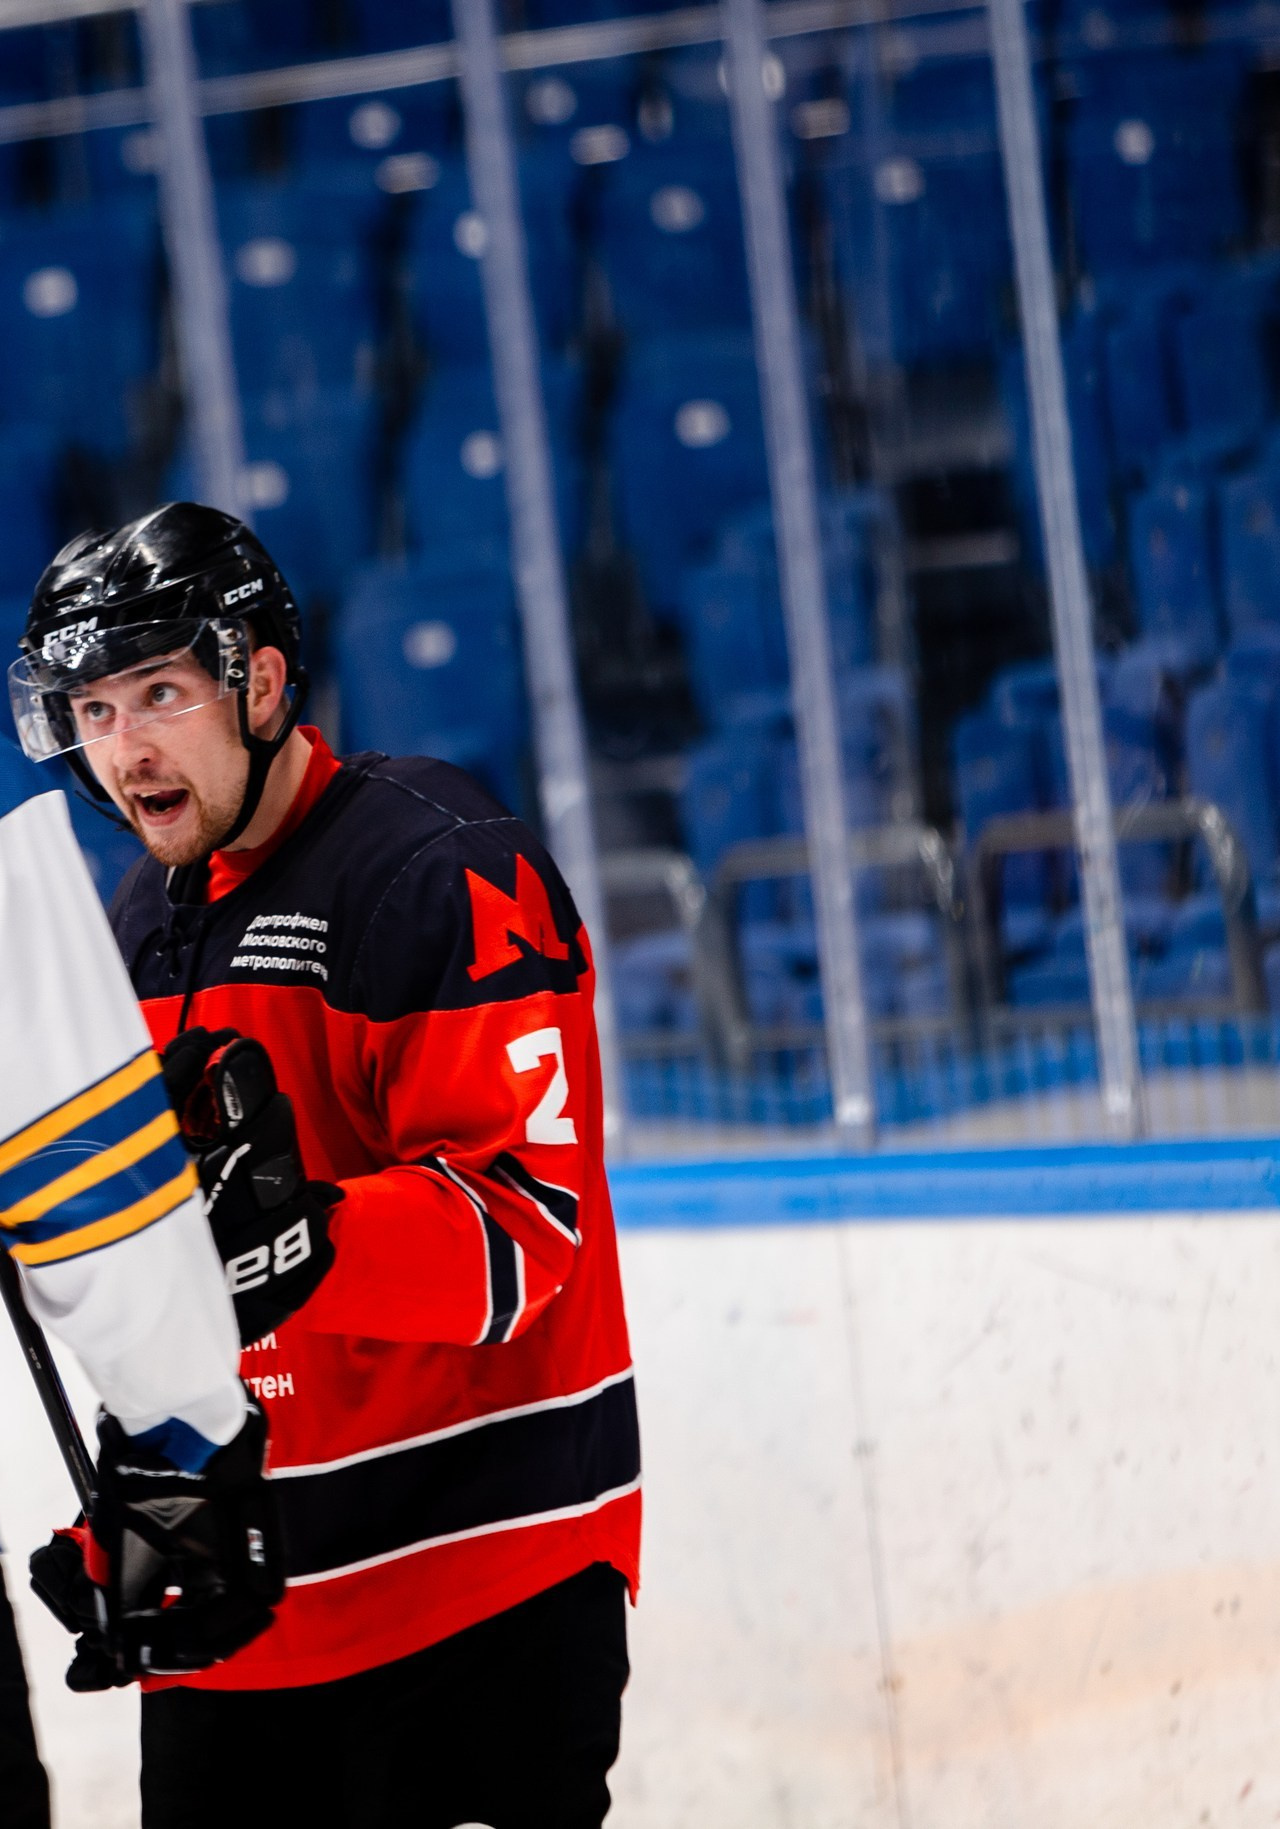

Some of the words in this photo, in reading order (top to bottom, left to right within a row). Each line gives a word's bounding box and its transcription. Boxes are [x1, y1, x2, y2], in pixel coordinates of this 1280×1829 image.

[222, 578, 264, 606] CCM
[42, 616, 99, 648] CCM
[238, 932, 327, 954] Московского
[505, 1026, 579, 1145] 2
